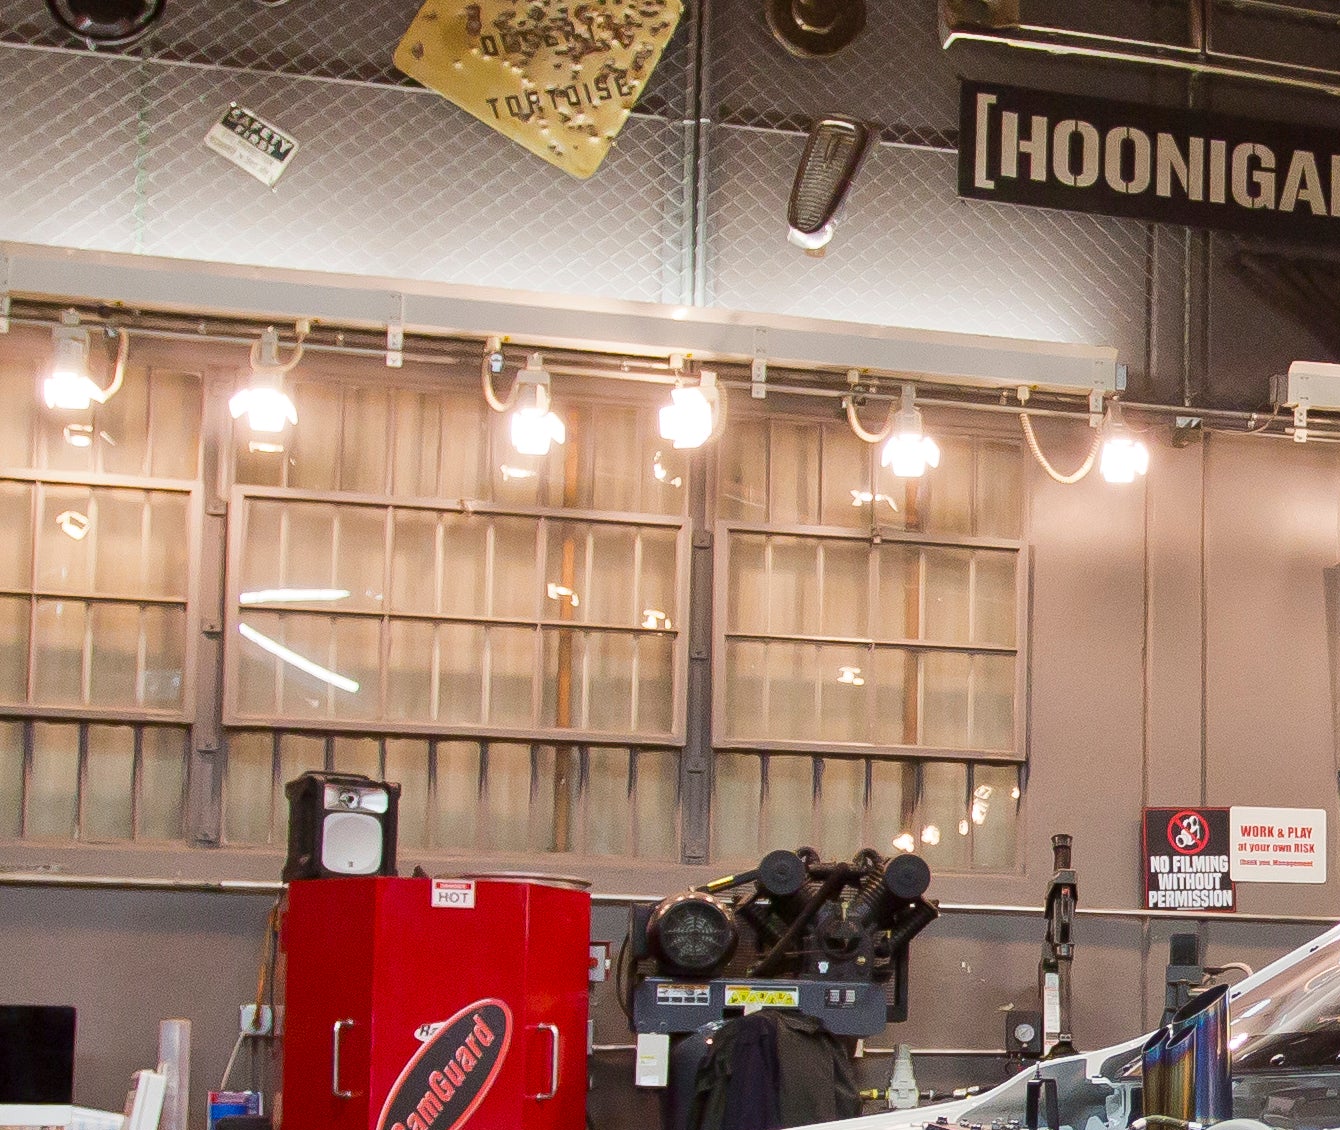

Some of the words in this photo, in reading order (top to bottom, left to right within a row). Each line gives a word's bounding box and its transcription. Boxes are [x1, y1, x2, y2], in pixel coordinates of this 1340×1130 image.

[486, 70, 633, 119] TORTOISE
[1240, 825, 1274, 837] WORK
[1277, 828, 1284, 838] &
[1288, 827, 1312, 839] PLAY
[1238, 843, 1247, 852] at
[1249, 844, 1270, 852] your
[1272, 844, 1292, 852] own
[1294, 843, 1315, 853] RISK
[1150, 855, 1170, 873] NO
[1173, 855, 1229, 873] FILMING
[1158, 873, 1222, 890] WITHOUT
[438, 892, 468, 903] HOT
[1148, 890, 1233, 907] PERMISSION
